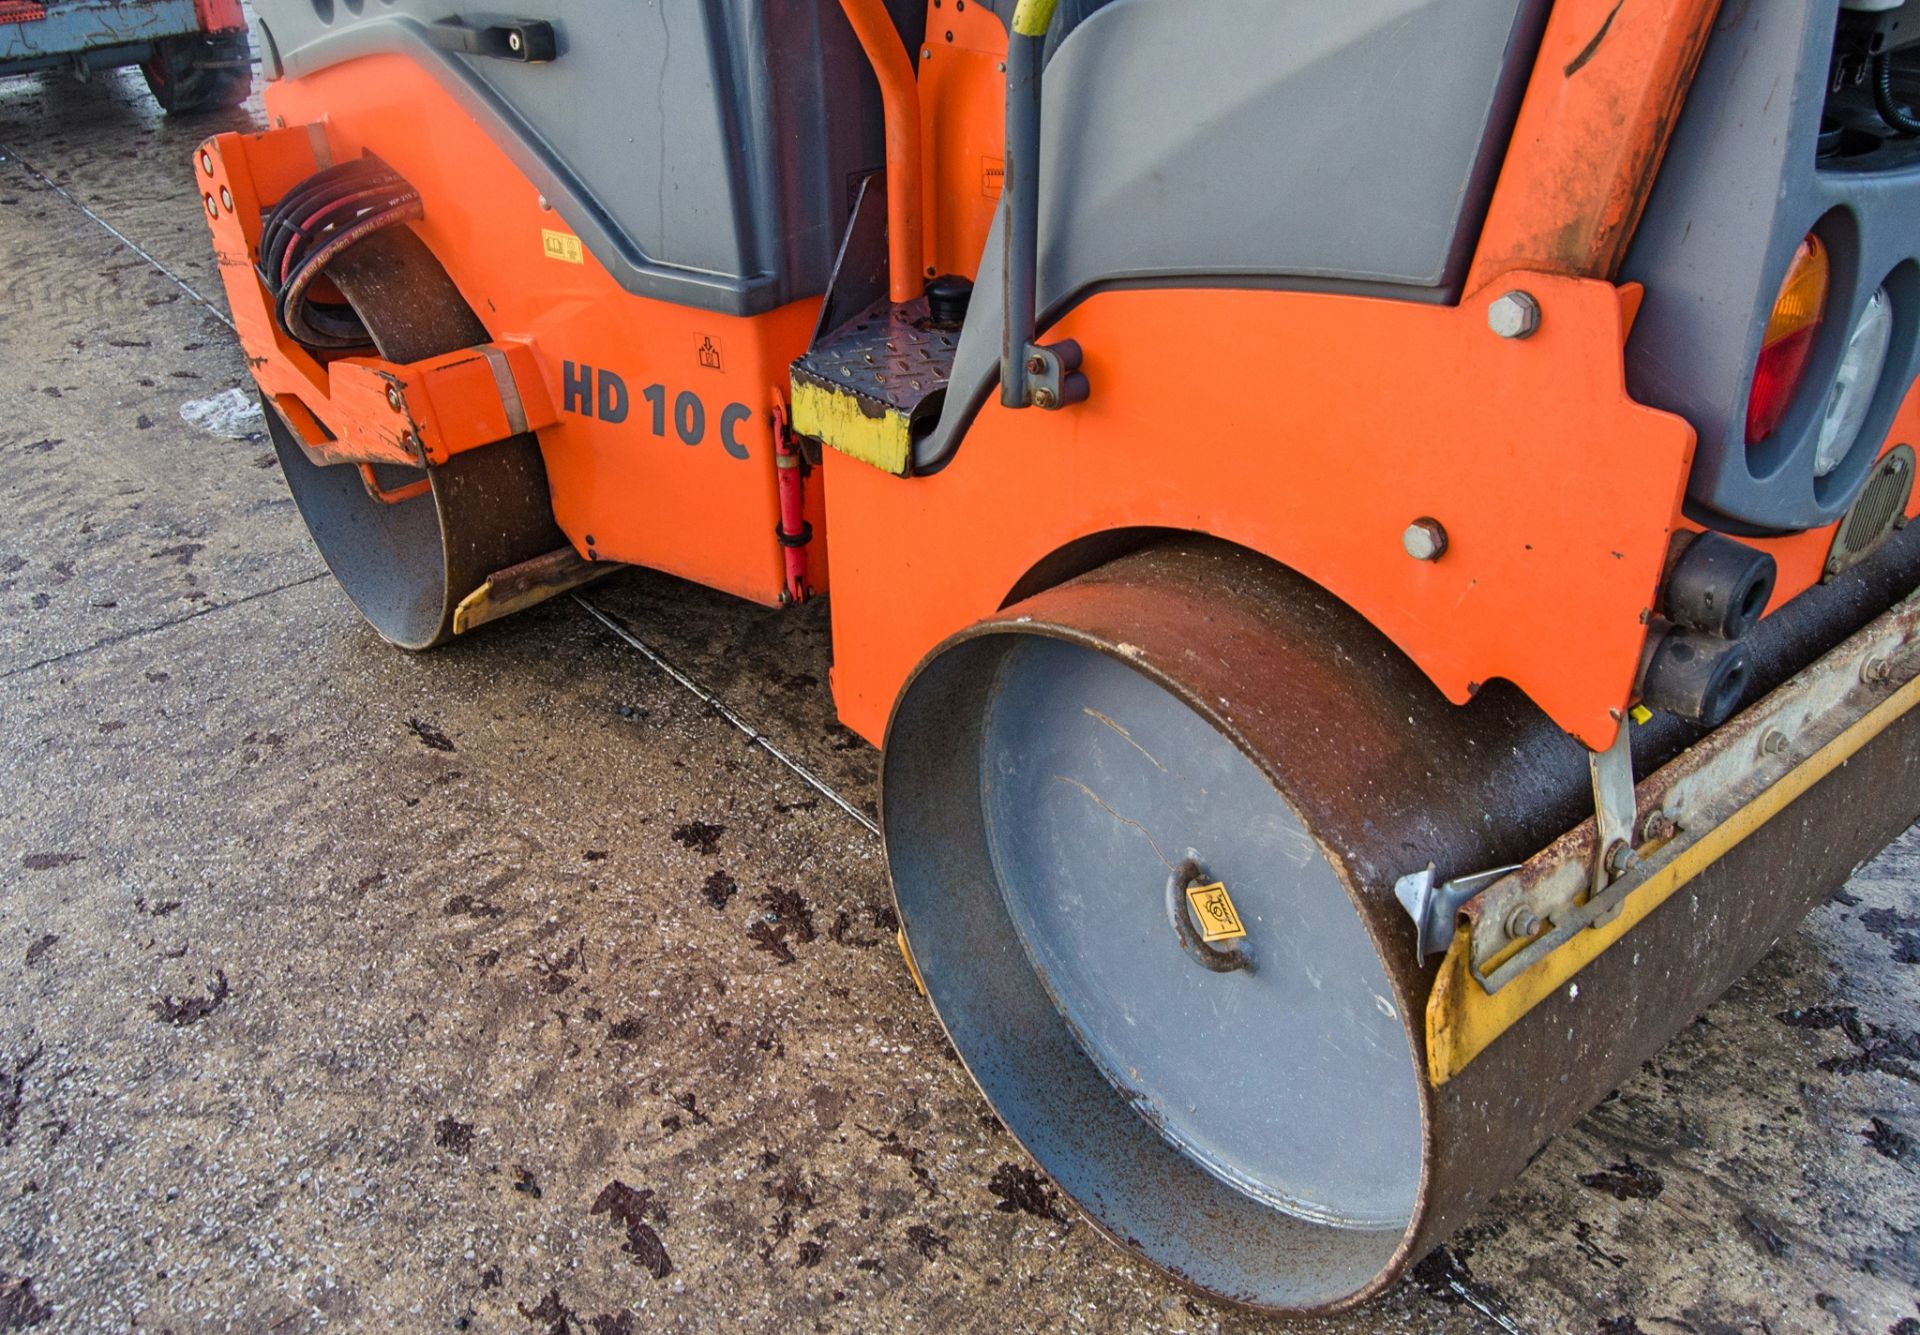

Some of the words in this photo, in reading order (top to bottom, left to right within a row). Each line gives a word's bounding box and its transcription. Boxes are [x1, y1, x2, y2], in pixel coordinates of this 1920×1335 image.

[563, 360, 629, 424] HD
[642, 383, 706, 446] 10
[720, 402, 752, 460] C
